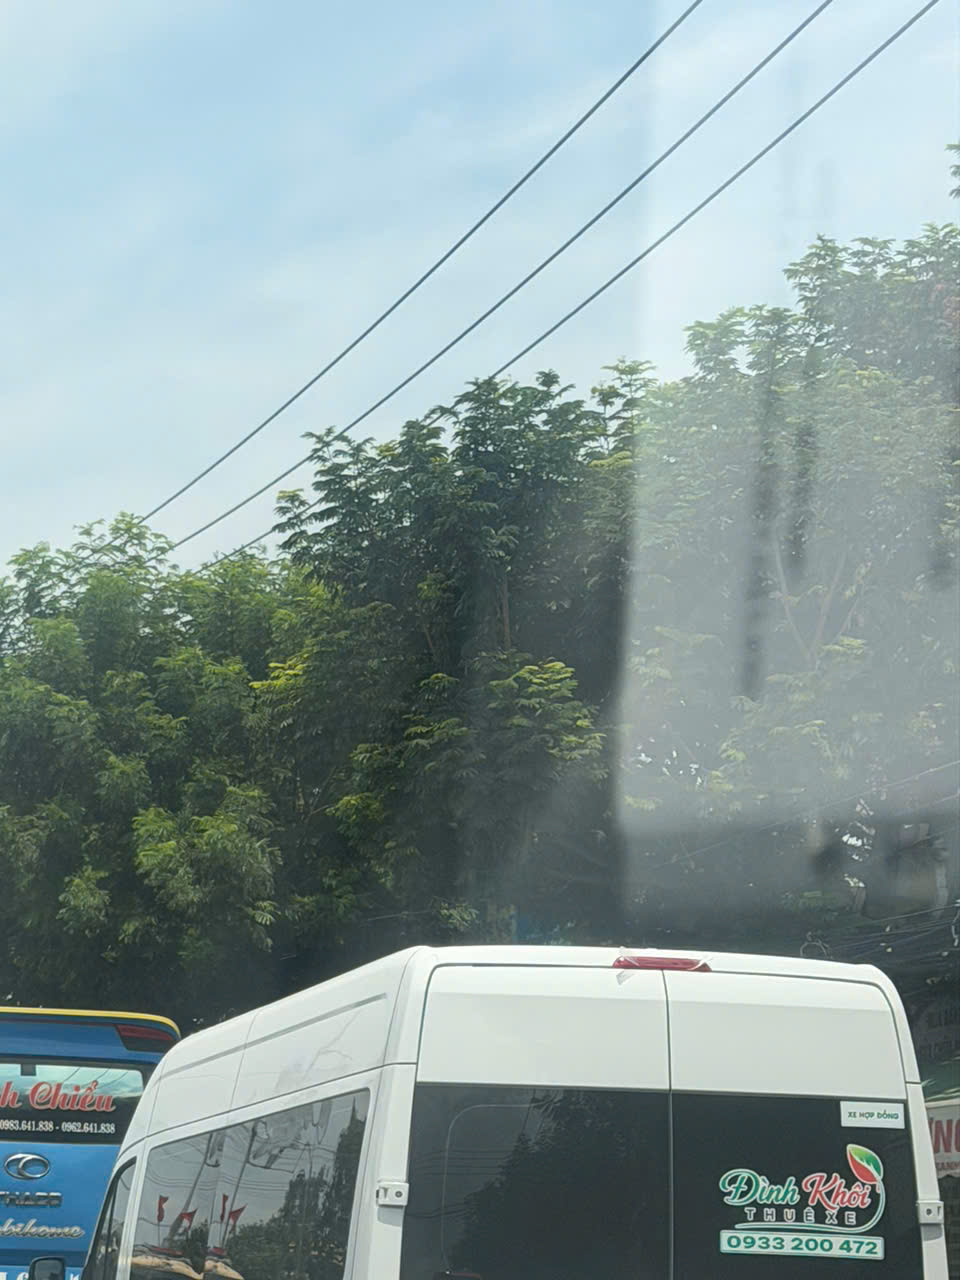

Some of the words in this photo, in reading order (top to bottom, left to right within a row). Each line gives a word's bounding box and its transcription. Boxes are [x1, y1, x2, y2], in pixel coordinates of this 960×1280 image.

[847, 1111, 857, 1119] XE
[719, 1168, 800, 1206] Đình
[802, 1172, 871, 1211] Khôi
[726, 1235, 785, 1250] 0933
[790, 1237, 834, 1252] 200
[838, 1239, 878, 1255] 472
